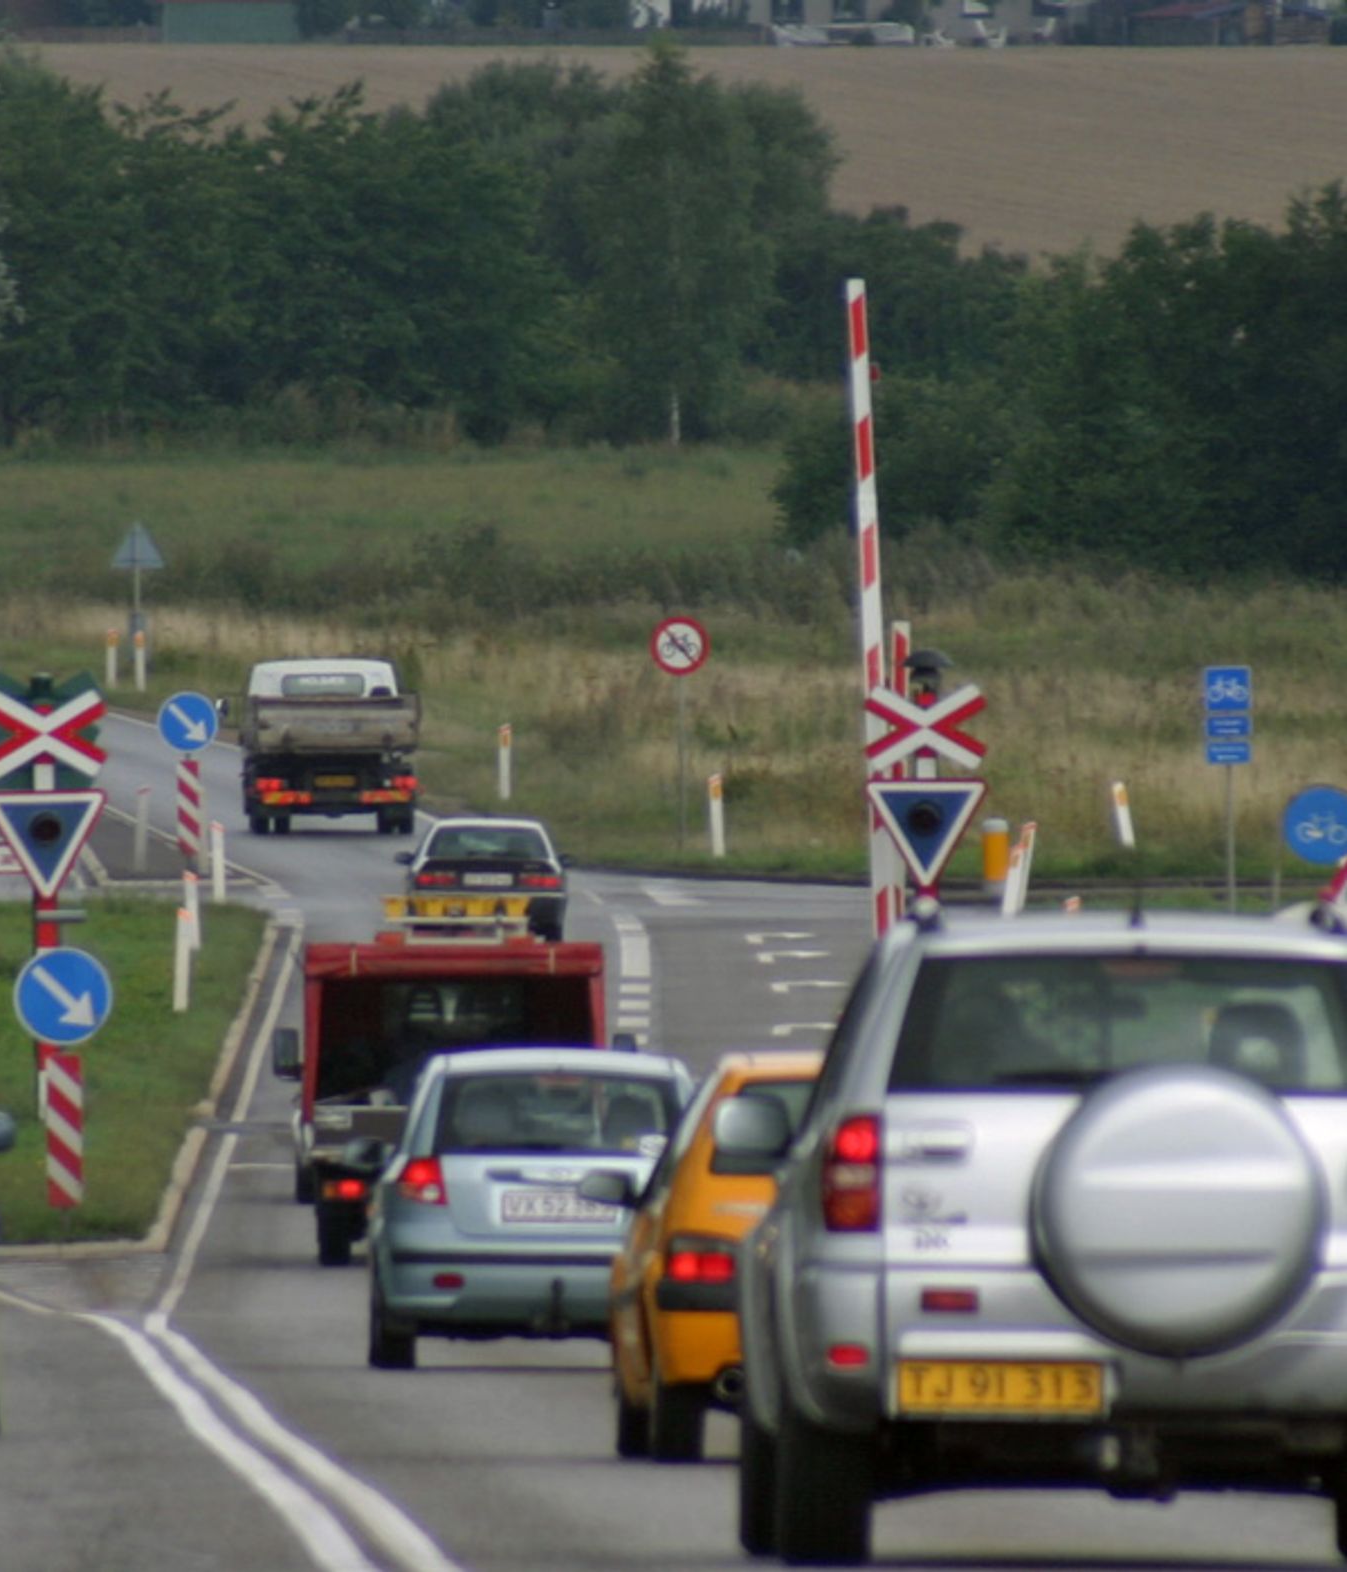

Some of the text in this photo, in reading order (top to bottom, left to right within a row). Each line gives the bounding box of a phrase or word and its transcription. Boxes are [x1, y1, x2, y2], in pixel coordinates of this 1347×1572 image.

[907, 1367, 1095, 1399] TJ 91 313
